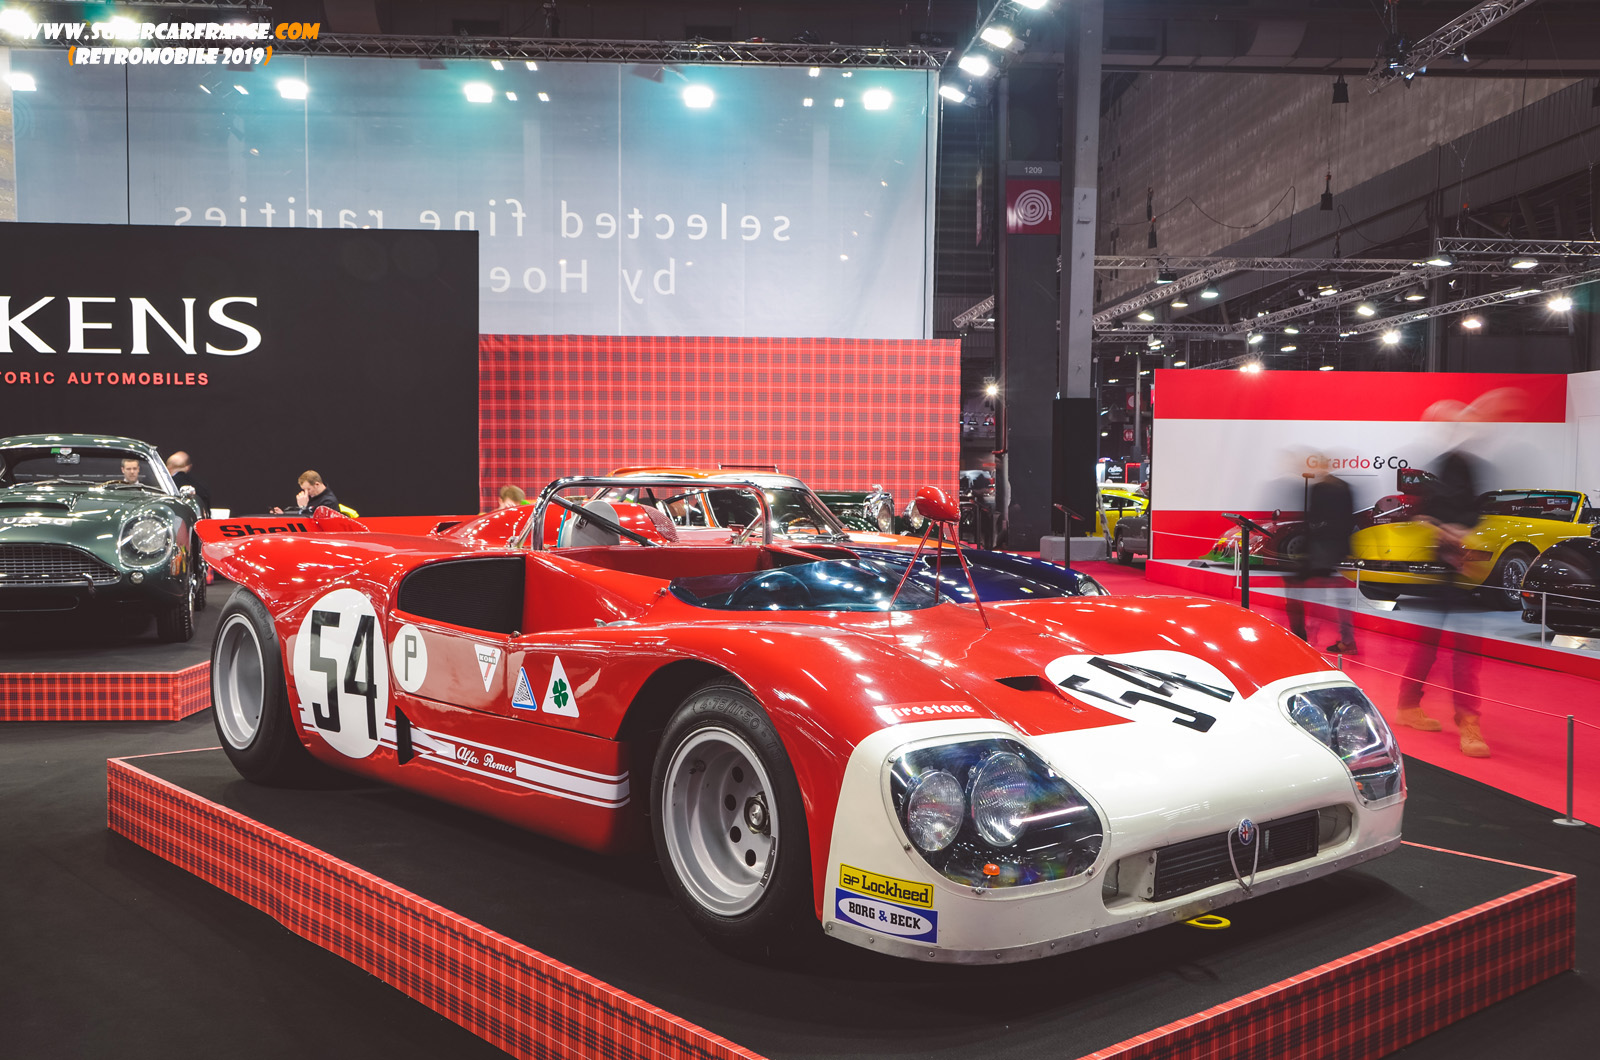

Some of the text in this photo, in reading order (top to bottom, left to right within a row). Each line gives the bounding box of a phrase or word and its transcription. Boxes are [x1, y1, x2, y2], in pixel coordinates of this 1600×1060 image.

[1024, 166, 1043, 174] 1209
[0, 295, 262, 356] KENS
[0, 371, 209, 386] ORIC AUTOMOBILES
[1306, 455, 1370, 469] Grardo
[219, 523, 308, 537] Shell
[404, 634, 417, 682] P
[309, 609, 378, 741] 54
[1058, 656, 1235, 733] 54
[881, 703, 975, 722] irestone
[457, 746, 515, 773] Alfa Romeo
[861, 874, 929, 903] Lockheed
[848, 901, 921, 930] BORG & BECK
